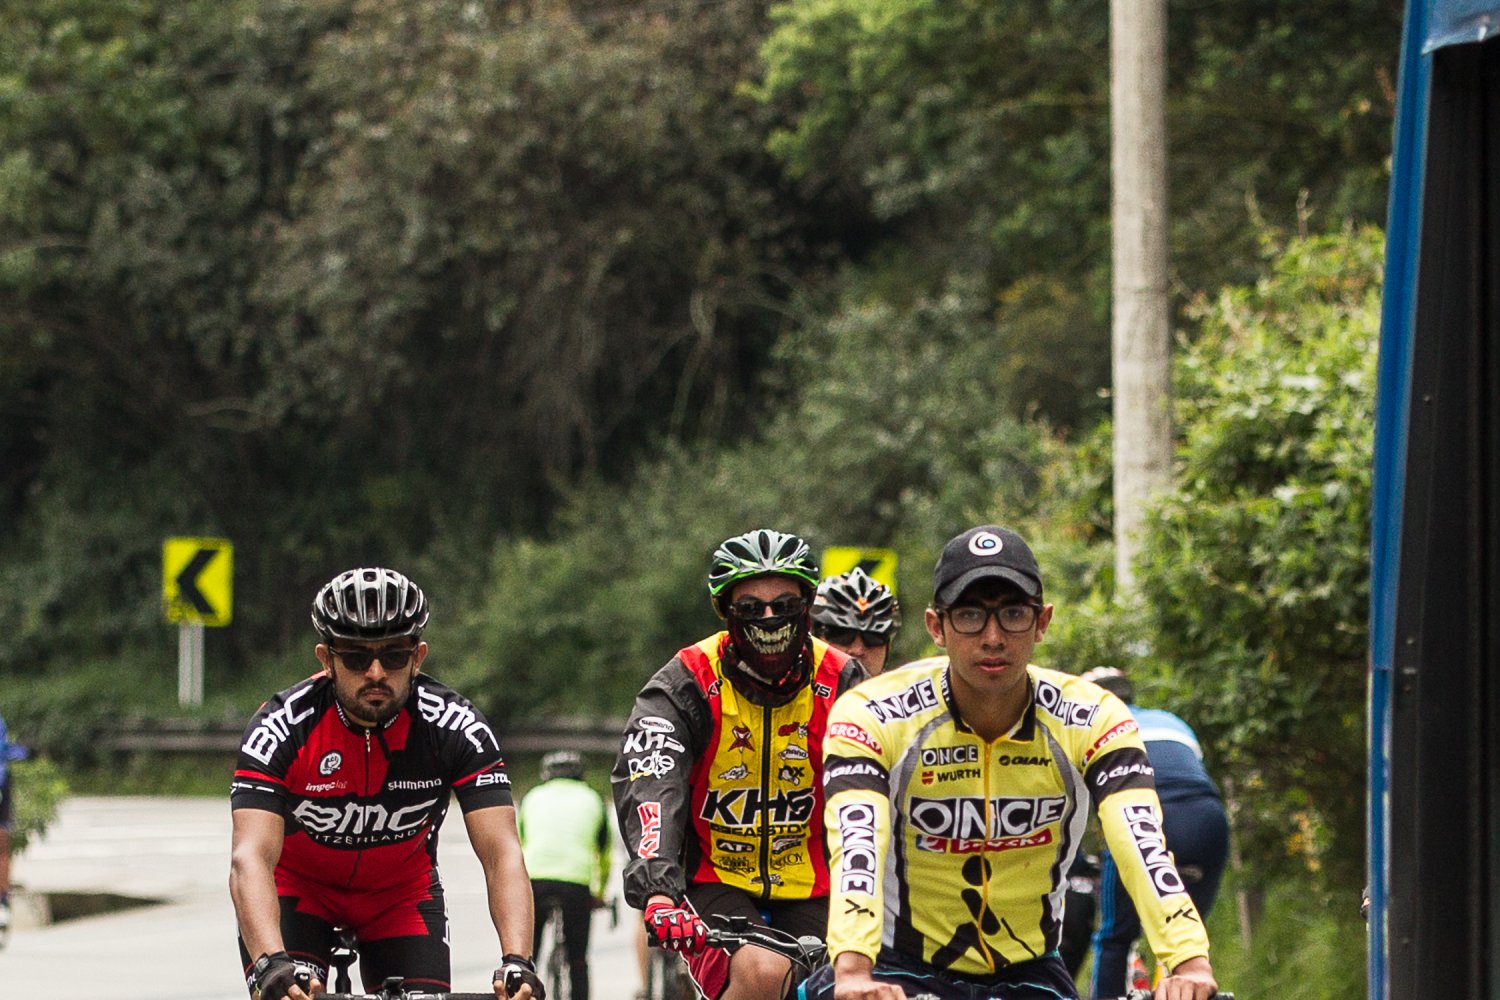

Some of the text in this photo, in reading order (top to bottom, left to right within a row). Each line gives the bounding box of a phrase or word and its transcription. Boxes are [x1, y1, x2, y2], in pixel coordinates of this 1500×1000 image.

[417, 686, 500, 753] BMC
[867, 680, 937, 722] ONCE
[1037, 683, 1099, 727] ONC
[242, 685, 314, 765] BMC
[921, 746, 979, 766] ONCE
[388, 778, 442, 790] SHIMANO
[292, 797, 439, 834] BMC
[699, 787, 816, 827] KHS
[911, 798, 1066, 838] ONCE
[840, 804, 875, 896] ONCE
[1124, 806, 1186, 898] ONCE
